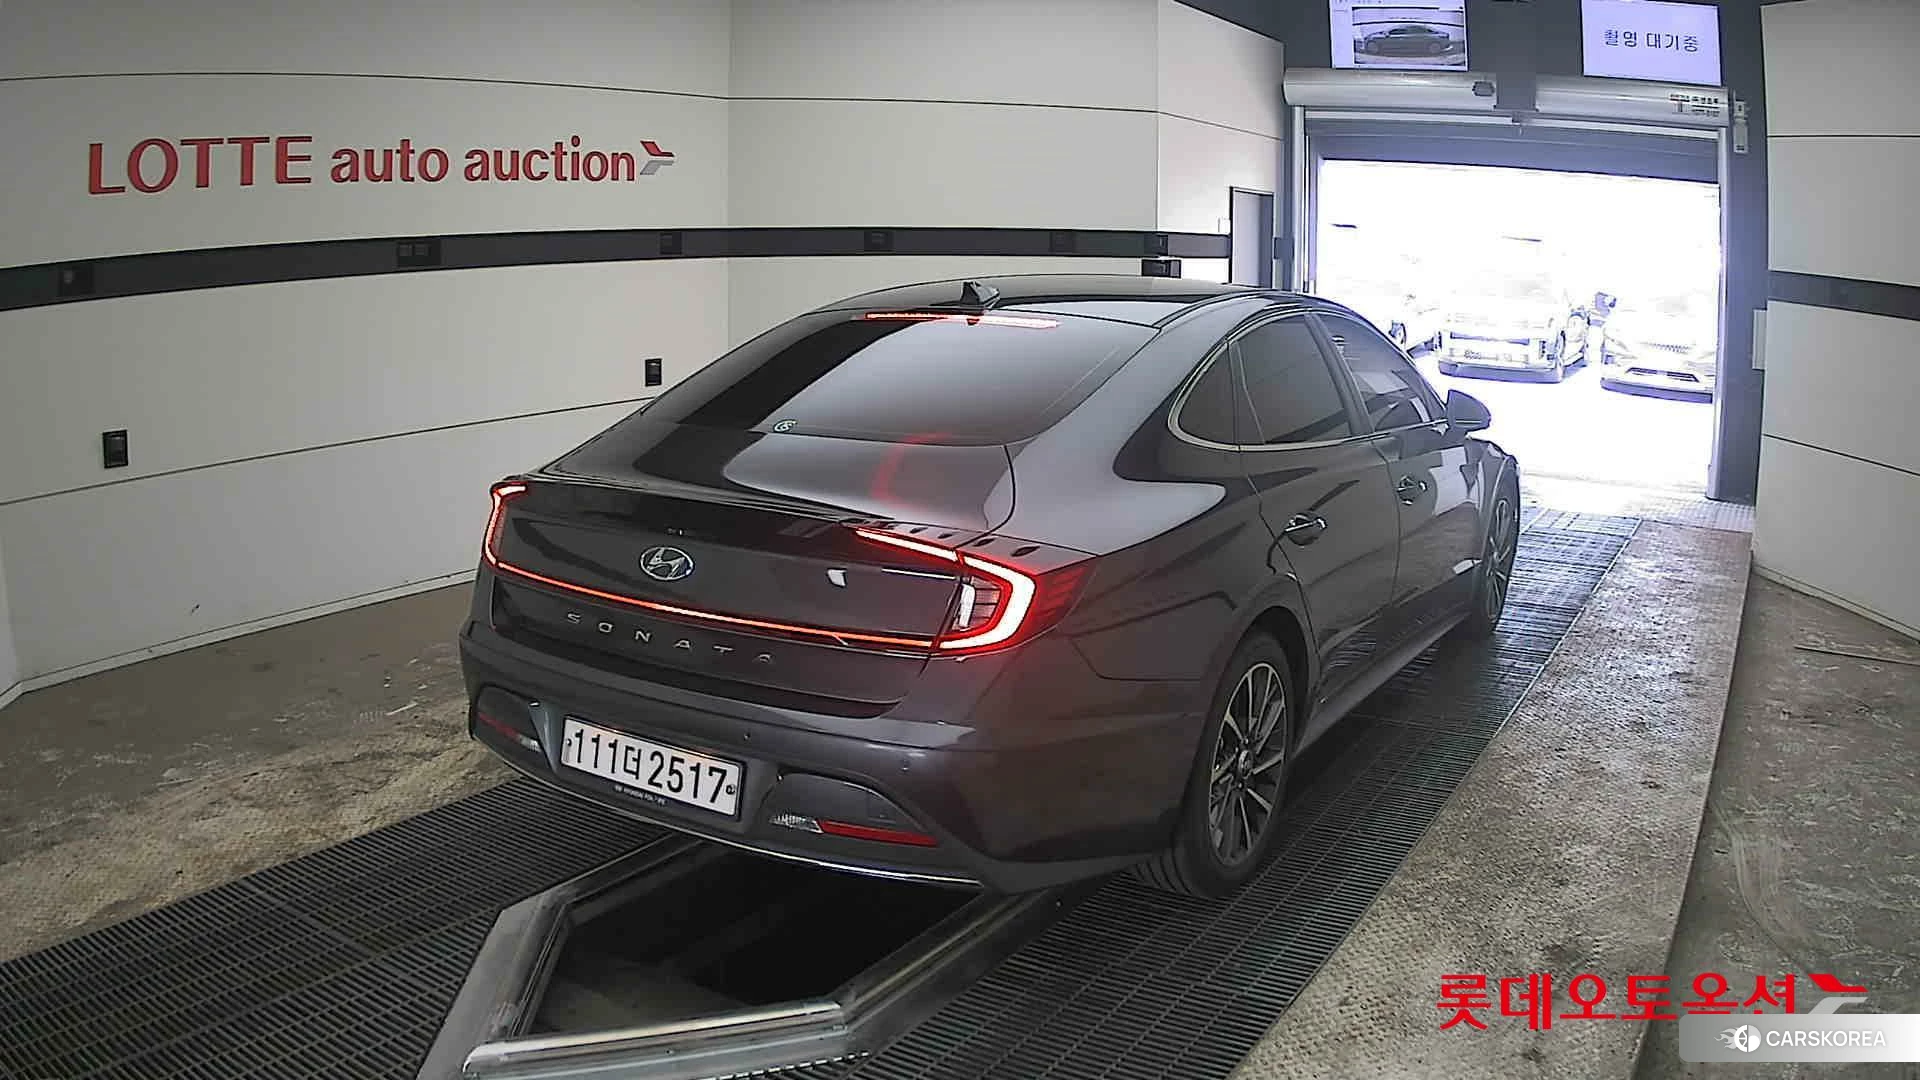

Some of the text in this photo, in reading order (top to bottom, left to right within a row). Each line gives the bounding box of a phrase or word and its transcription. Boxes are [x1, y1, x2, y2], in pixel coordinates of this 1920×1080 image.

[1645, 32, 1699, 53] 대기중
[88, 135, 635, 195] LOTTE auto auction
[567, 612, 773, 664] SONATA
